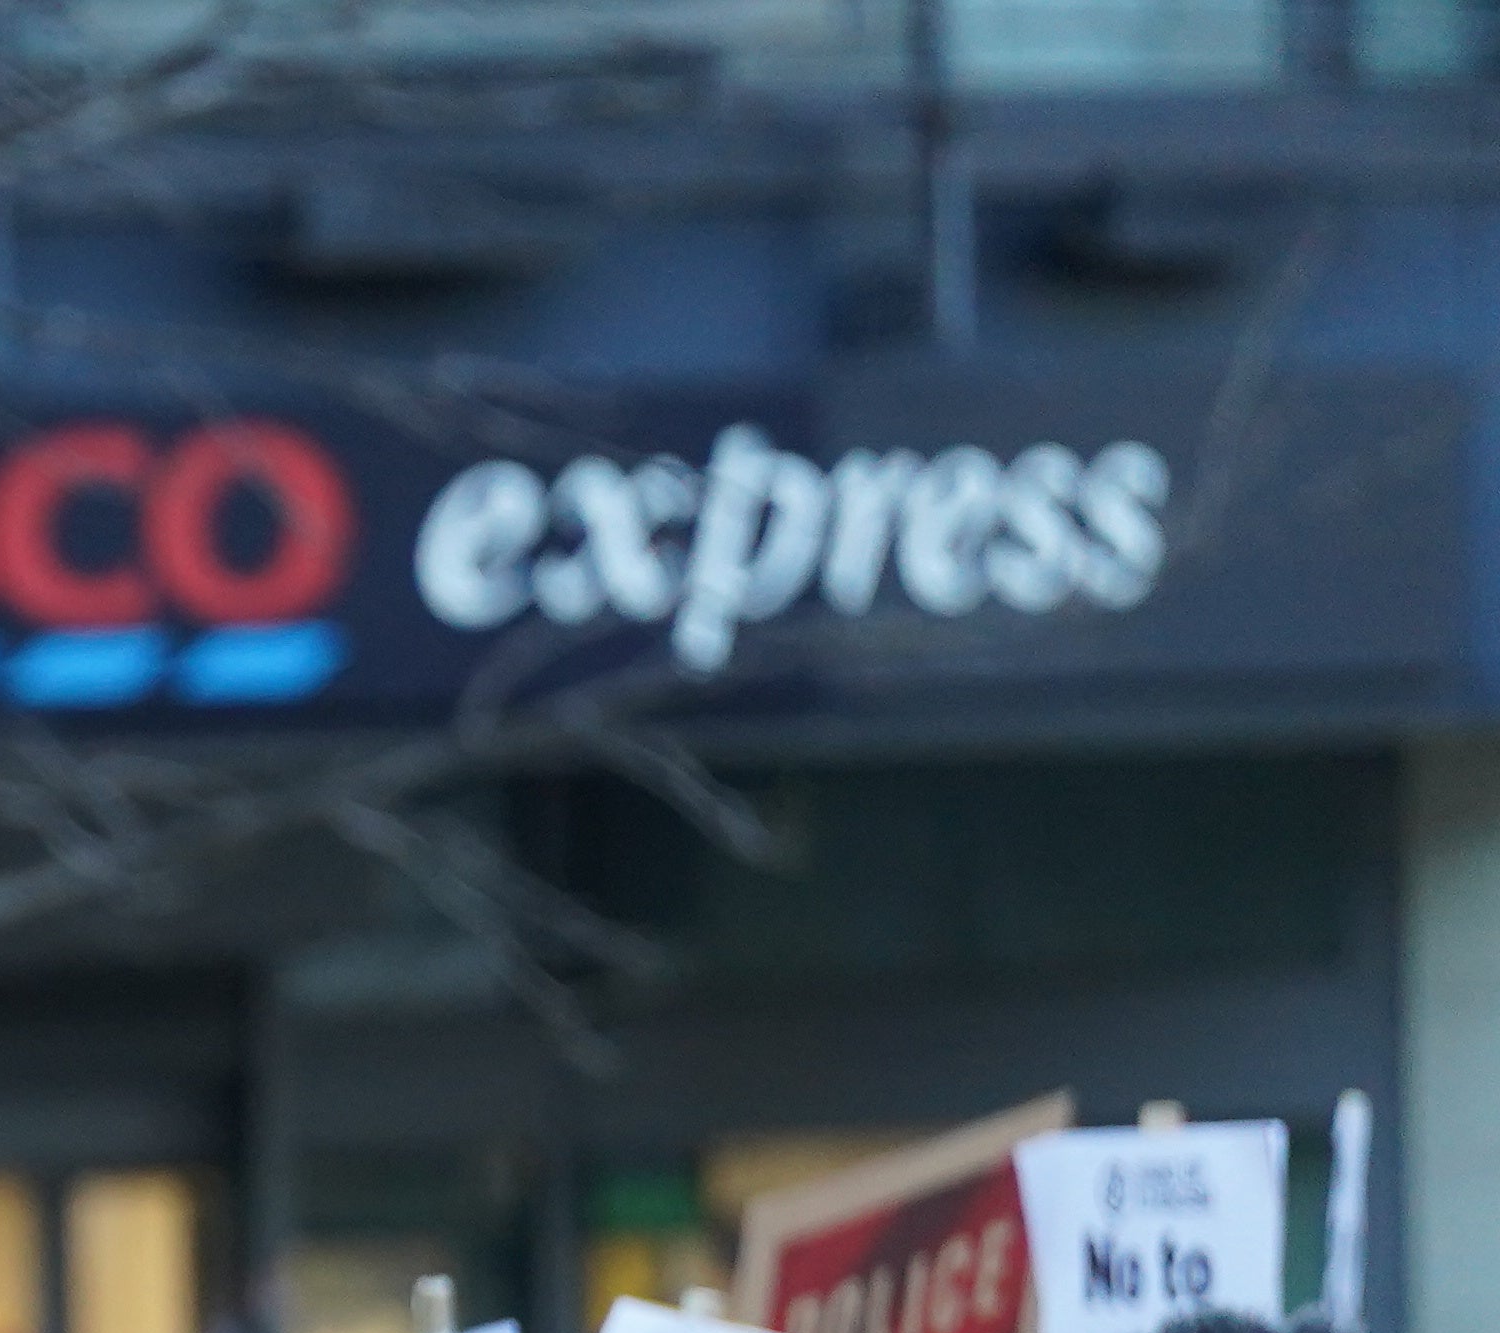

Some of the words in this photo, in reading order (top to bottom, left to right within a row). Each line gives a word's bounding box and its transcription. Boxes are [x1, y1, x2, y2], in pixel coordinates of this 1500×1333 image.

[415, 424, 1172, 688] express
[1083, 1232, 1140, 1302] No
[1162, 1234, 1213, 1300] to
